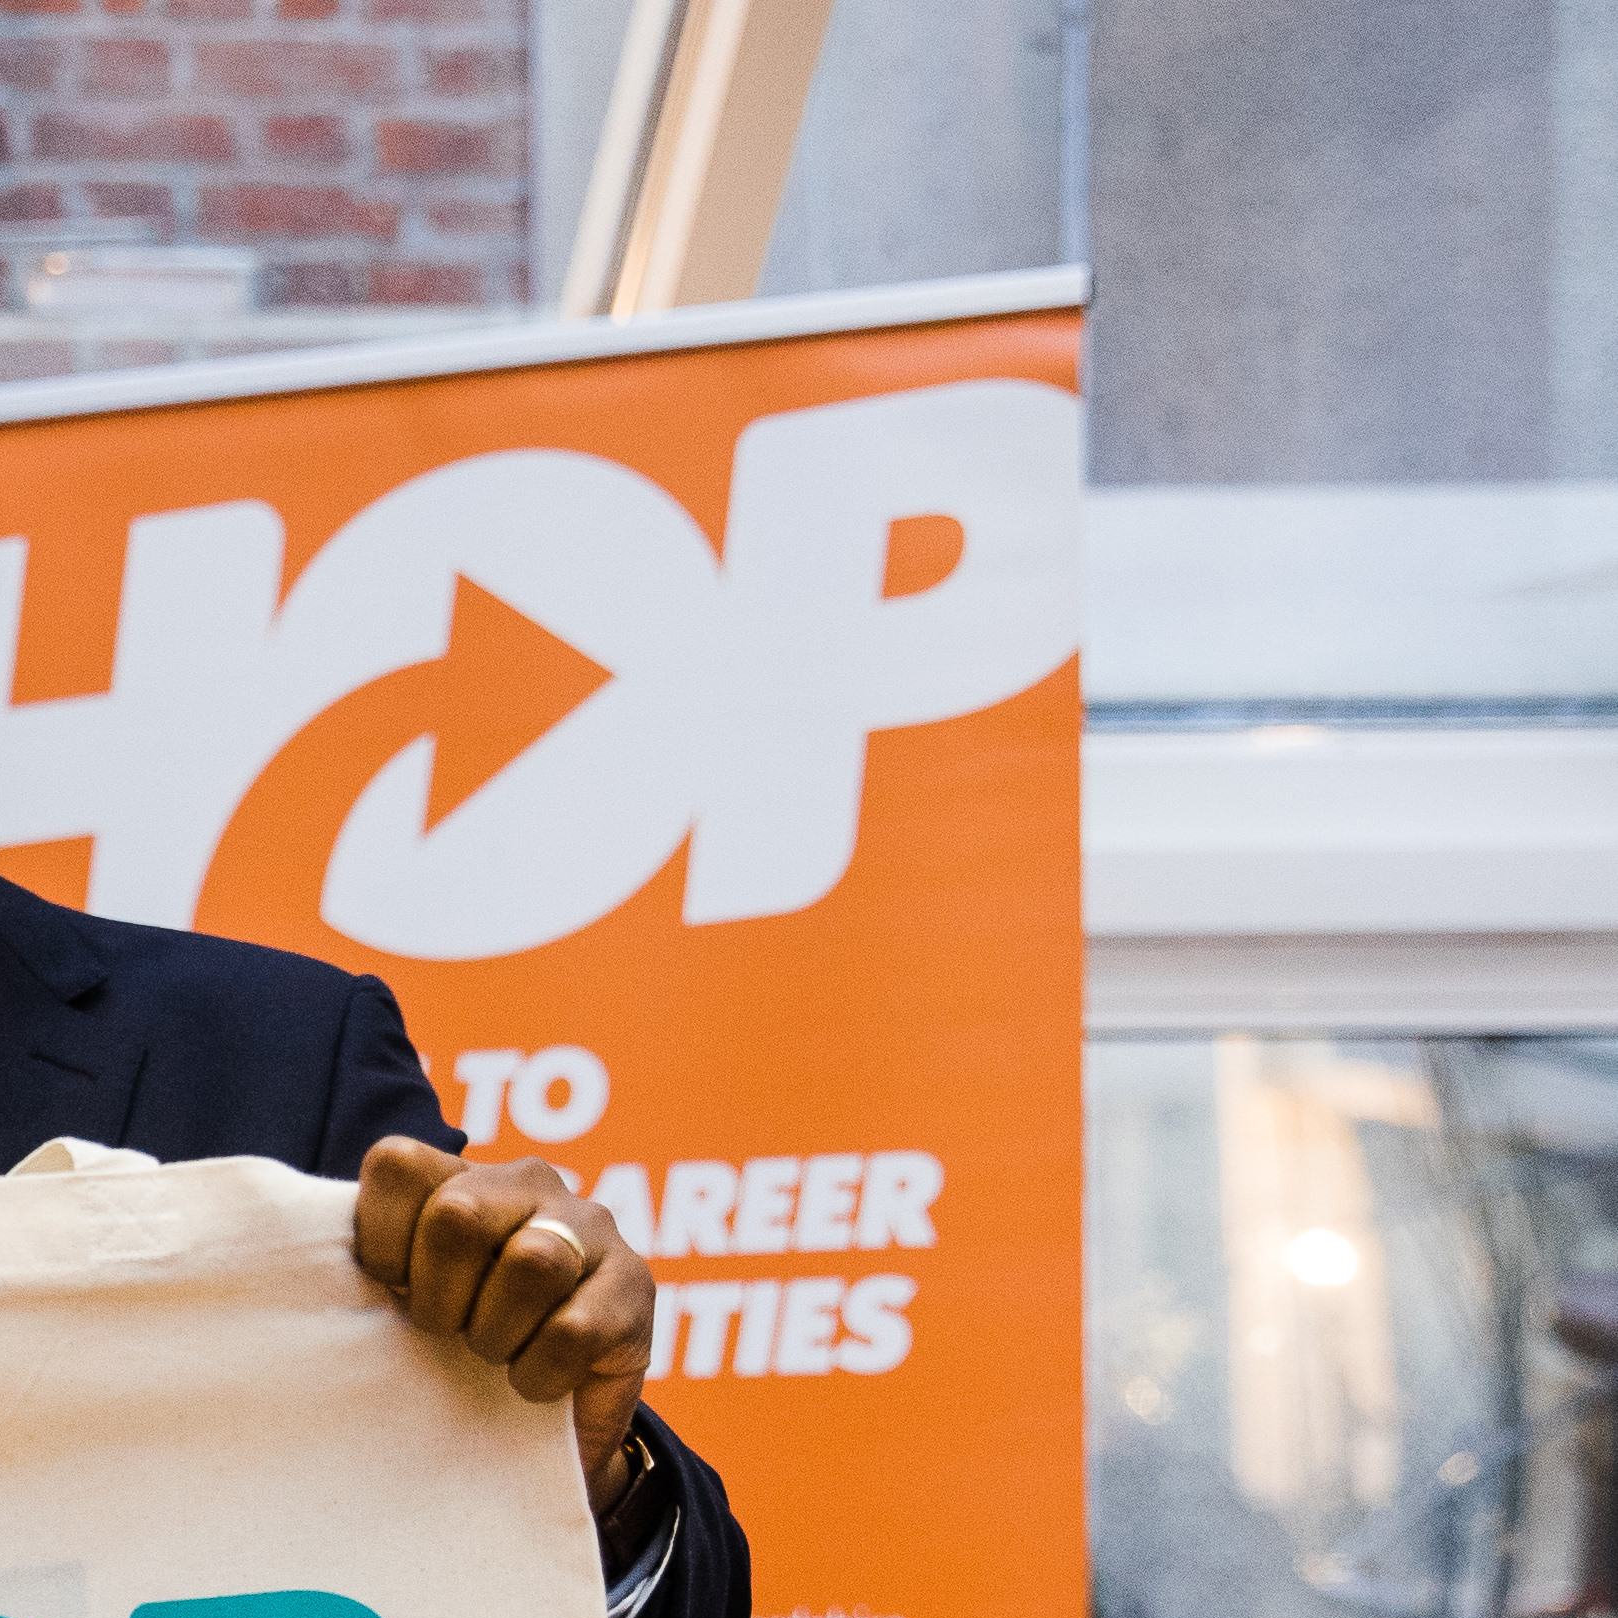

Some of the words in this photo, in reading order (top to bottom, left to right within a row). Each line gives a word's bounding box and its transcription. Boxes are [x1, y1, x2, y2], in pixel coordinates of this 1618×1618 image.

[453, 1043, 611, 1145] TO
[555, 1149, 945, 1258] AREER
[645, 1272, 918, 1382] ITIES
